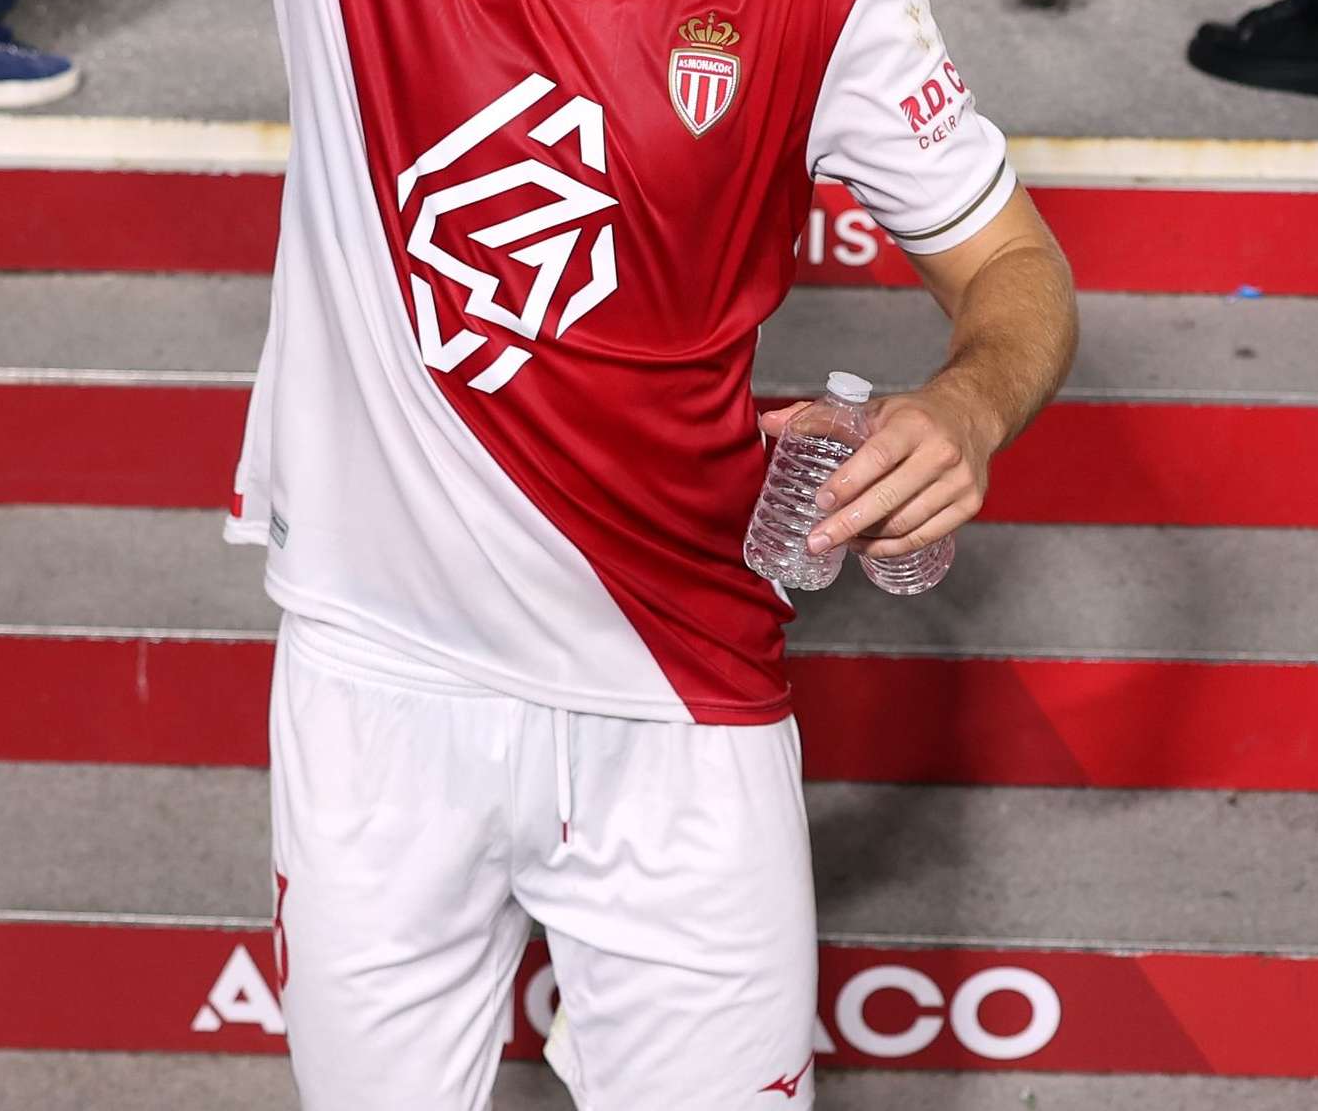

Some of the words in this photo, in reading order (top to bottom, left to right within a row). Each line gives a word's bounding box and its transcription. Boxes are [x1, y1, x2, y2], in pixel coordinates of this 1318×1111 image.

[943, 62, 967, 94] C
[808, 209, 879, 266] IS
[190, 943, 287, 1035] A
